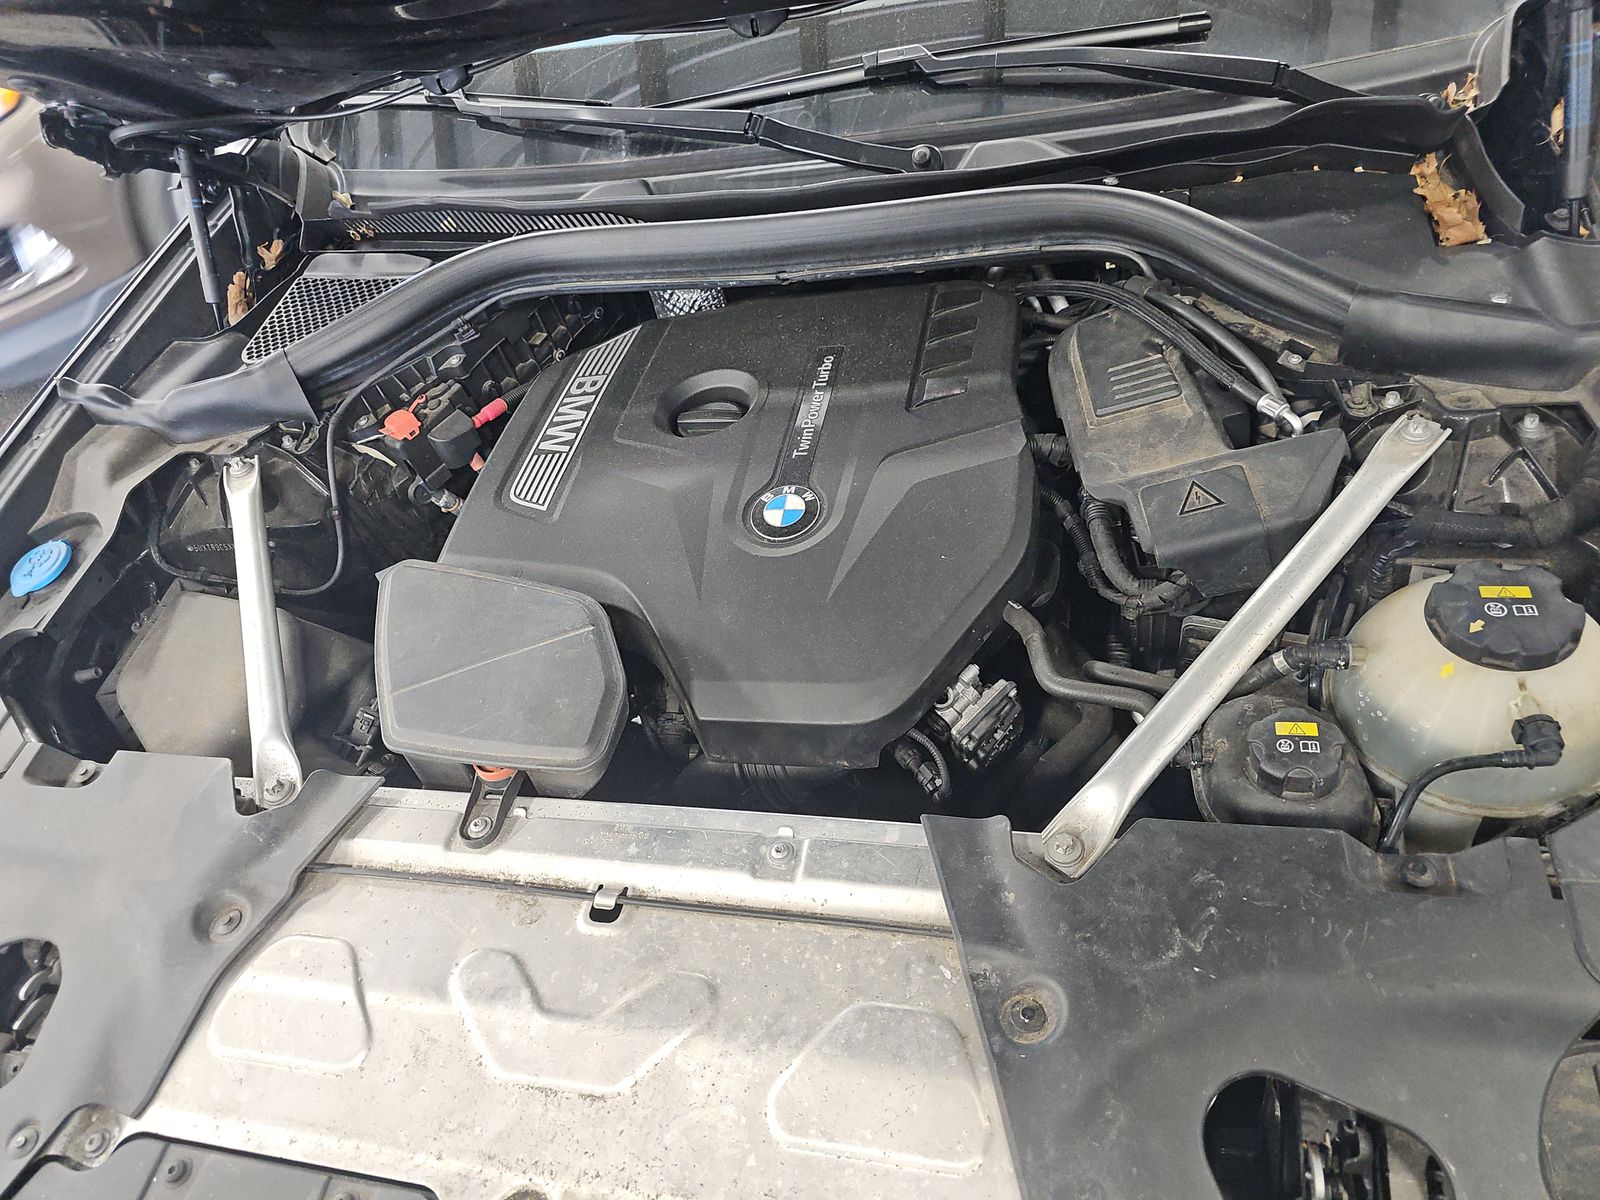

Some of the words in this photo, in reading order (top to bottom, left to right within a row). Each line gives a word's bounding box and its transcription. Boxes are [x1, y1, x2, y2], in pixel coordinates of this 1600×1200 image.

[538, 374, 608, 452] BMW
[792, 389, 825, 459] TwinPower
[760, 485, 816, 503] BMW
